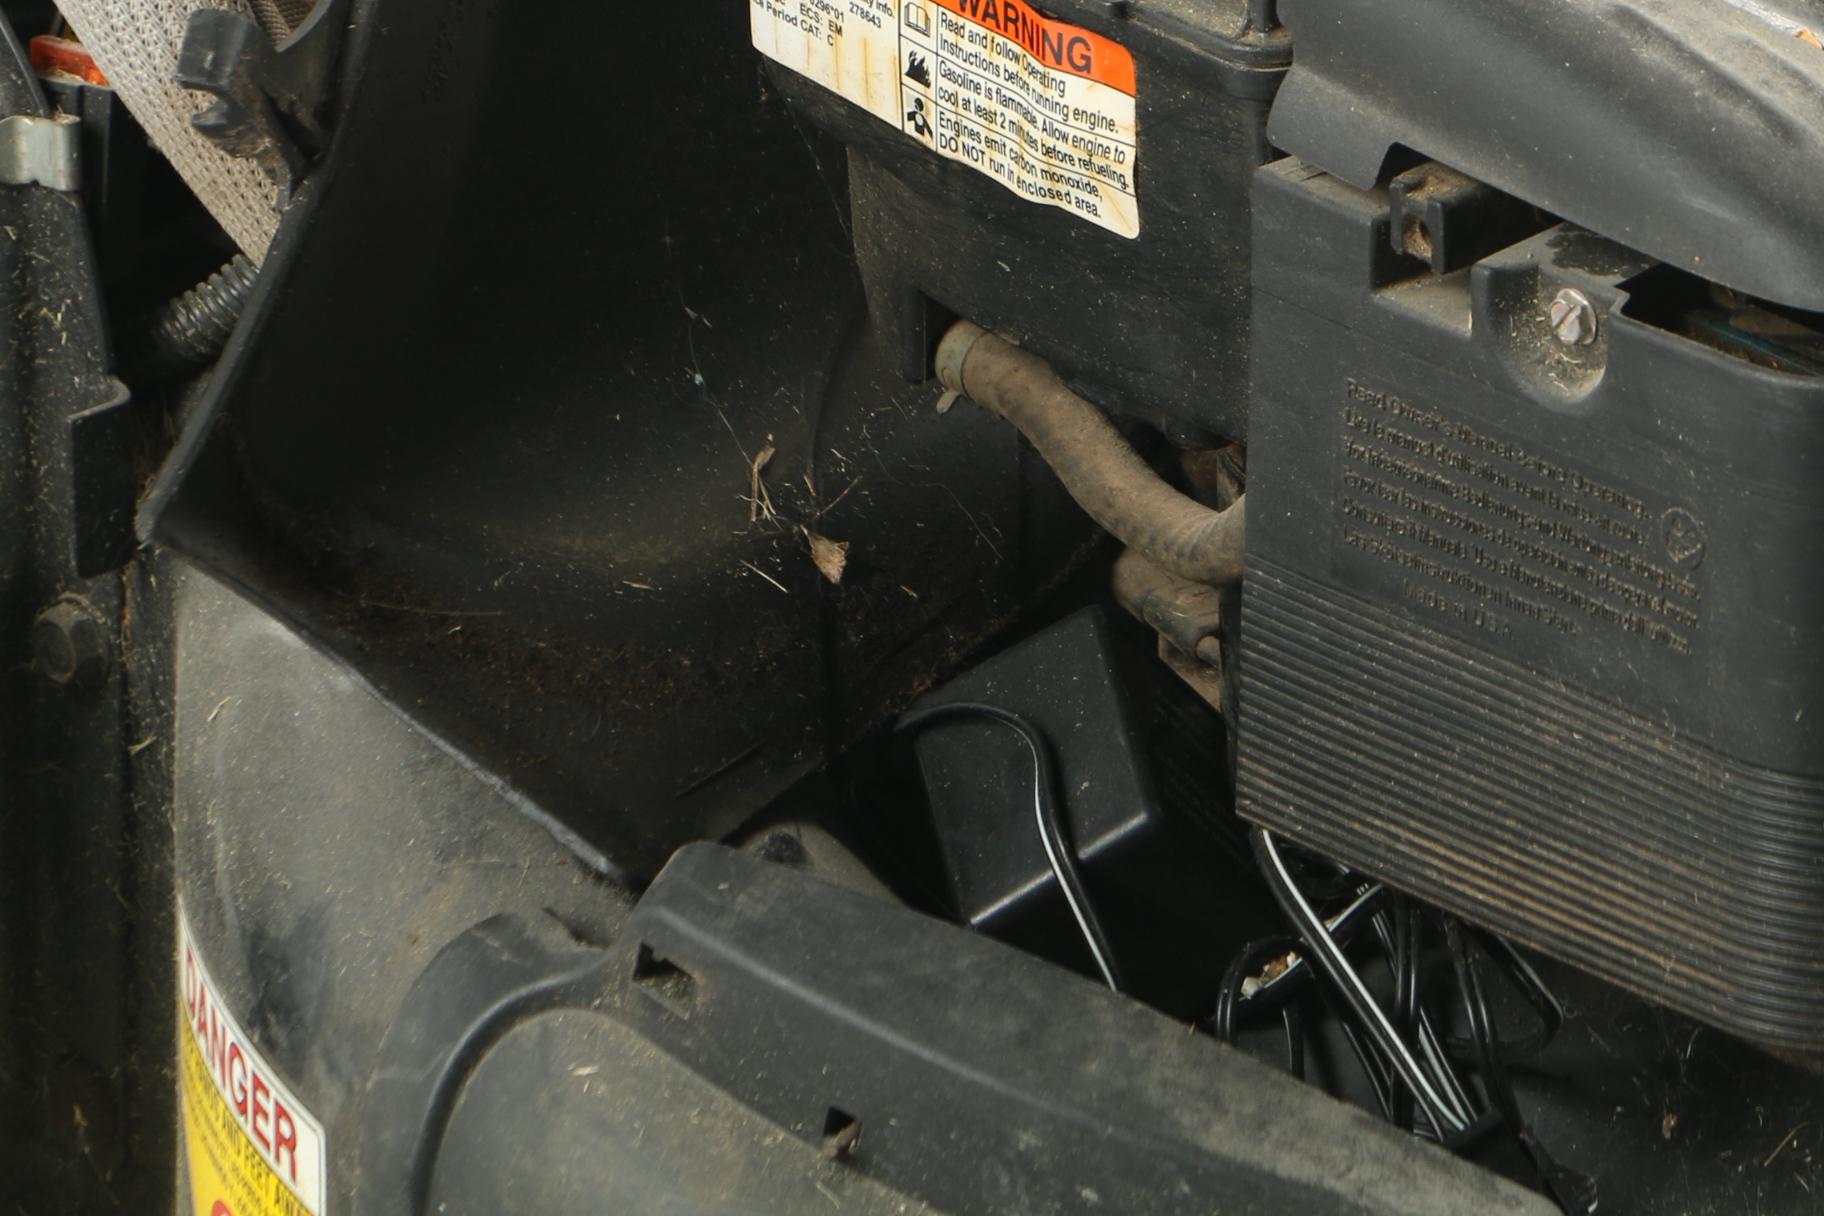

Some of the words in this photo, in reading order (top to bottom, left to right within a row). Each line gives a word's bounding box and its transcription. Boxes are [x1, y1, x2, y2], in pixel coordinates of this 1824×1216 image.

[766, 0, 798, 26] Period
[799, 19, 822, 40] CAT:
[826, 34, 835, 47] C
[799, 3, 824, 26] ECS:
[827, 19, 843, 37] EM
[848, 1, 882, 29] 278643
[940, 11, 965, 39] Read
[967, 25, 988, 50] and
[988, 35, 1021, 66] follow
[1021, 53, 1066, 99] Operating
[938, 60, 983, 96] Gasoline
[983, 81, 994, 102] is
[994, 88, 1040, 131] flammable.
[1041, 117, 1070, 145] Allow
[1071, 134, 1112, 161] engine
[1113, 145, 1126, 165] to
[939, 34, 1001, 77] Instructions
[1003, 63, 1031, 97] before
[1031, 87, 1070, 122] running
[1072, 107, 1120, 134] engine.
[938, 86, 960, 108] cool
[961, 96, 973, 112] at
[973, 100, 998, 126] least
[998, 113, 1007, 130] 2
[1008, 119, 1039, 151] minutes
[1041, 138, 1076, 166] before
[1077, 155, 1131, 191] refueling.
[938, 111, 983, 145] Engines
[984, 135, 1008, 157] emit
[1008, 146, 1039, 178] carbon
[1040, 167, 1104, 202] monoxide,
[938, 133, 960, 153] DO
[961, 144, 986, 166] NOT
[989, 157, 1007, 176] run
[1006, 163, 1016, 182] in
[1015, 175, 1072, 205] enclosed
[1073, 197, 1102, 218] area.
[1346, 377, 1388, 411] Read
[1391, 395, 1453, 436] Owner's
[1404, 577, 1447, 612] Made
[186, 946, 298, 1186] DANGER
